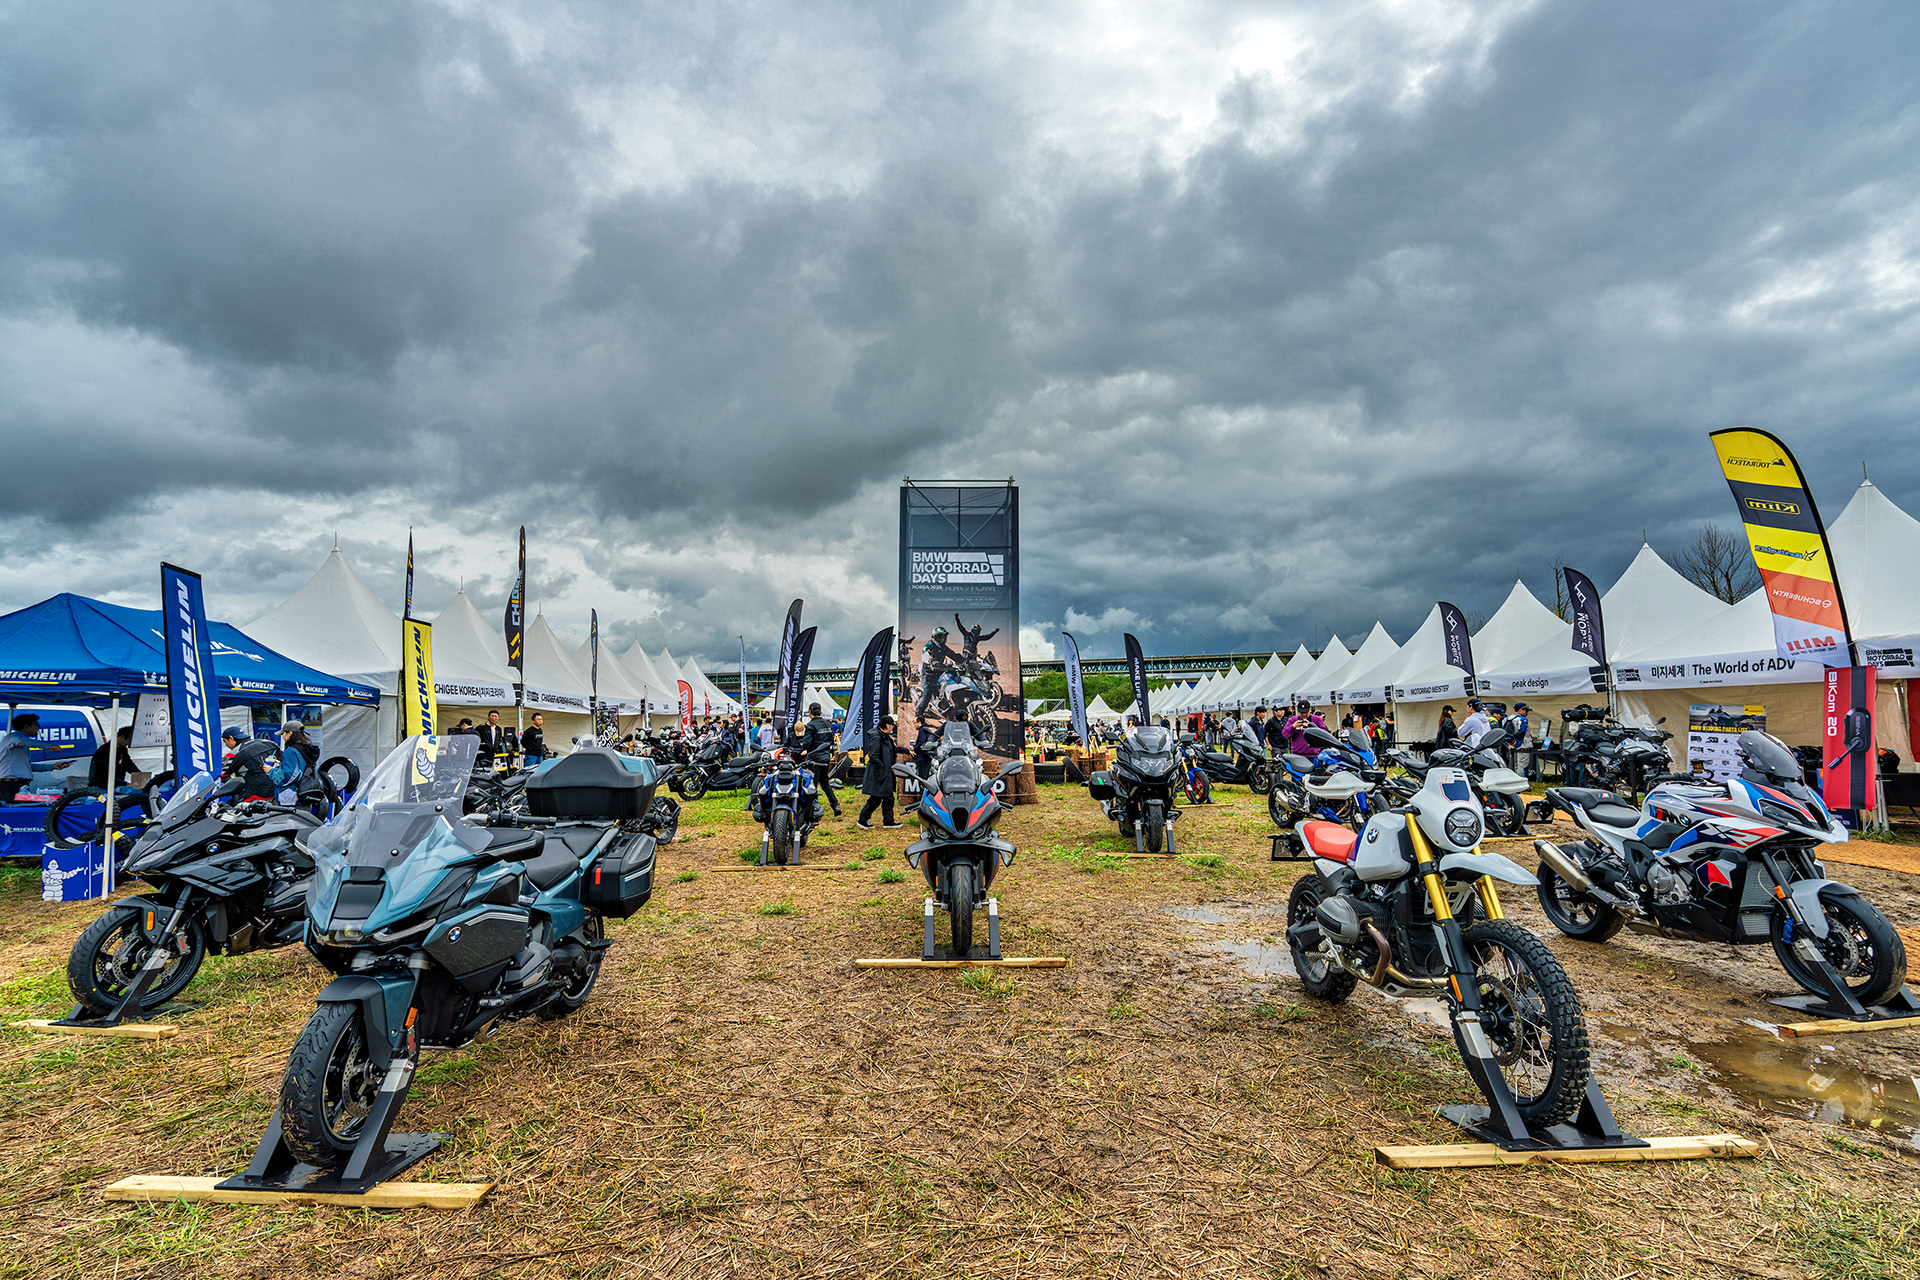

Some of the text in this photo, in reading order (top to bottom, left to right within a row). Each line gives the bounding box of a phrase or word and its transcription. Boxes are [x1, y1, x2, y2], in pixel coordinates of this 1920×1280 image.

[912, 552, 947, 562] BMW
[912, 563, 990, 573] MOTORRAD
[912, 573, 946, 583] DAYS
[794, 653, 803, 679] MAKE
[873, 655, 883, 681] MAKE
[1133, 657, 1141, 680] MAKE
[1651, 664, 1685, 678] 미지세계
[1692, 657, 1796, 676] The World of ADV
[0, 671, 77, 680] MICHELIN
[176, 577, 208, 772] MICHELIN
[242, 681, 275, 690] MICHELIN
[305, 685, 329, 694] MICHELIN
[413, 626, 437, 746] MICHELIN
[434, 683, 459, 694] CHIGEE
[790, 680, 799, 699] LIFE
[873, 681, 881, 700] LIFE
[1134, 681, 1142, 700] LIFE
[1410, 687, 1431, 695] MOTORRAD
[1431, 684, 1450, 693] MEISTER
[1511, 677, 1549, 690] peak design
[1827, 671, 1838, 713] BiKom
[789, 699, 796, 707] A
[873, 702, 880, 710] A
[1827, 716, 1838, 737] 20
[31, 727, 88, 742] HELIN
